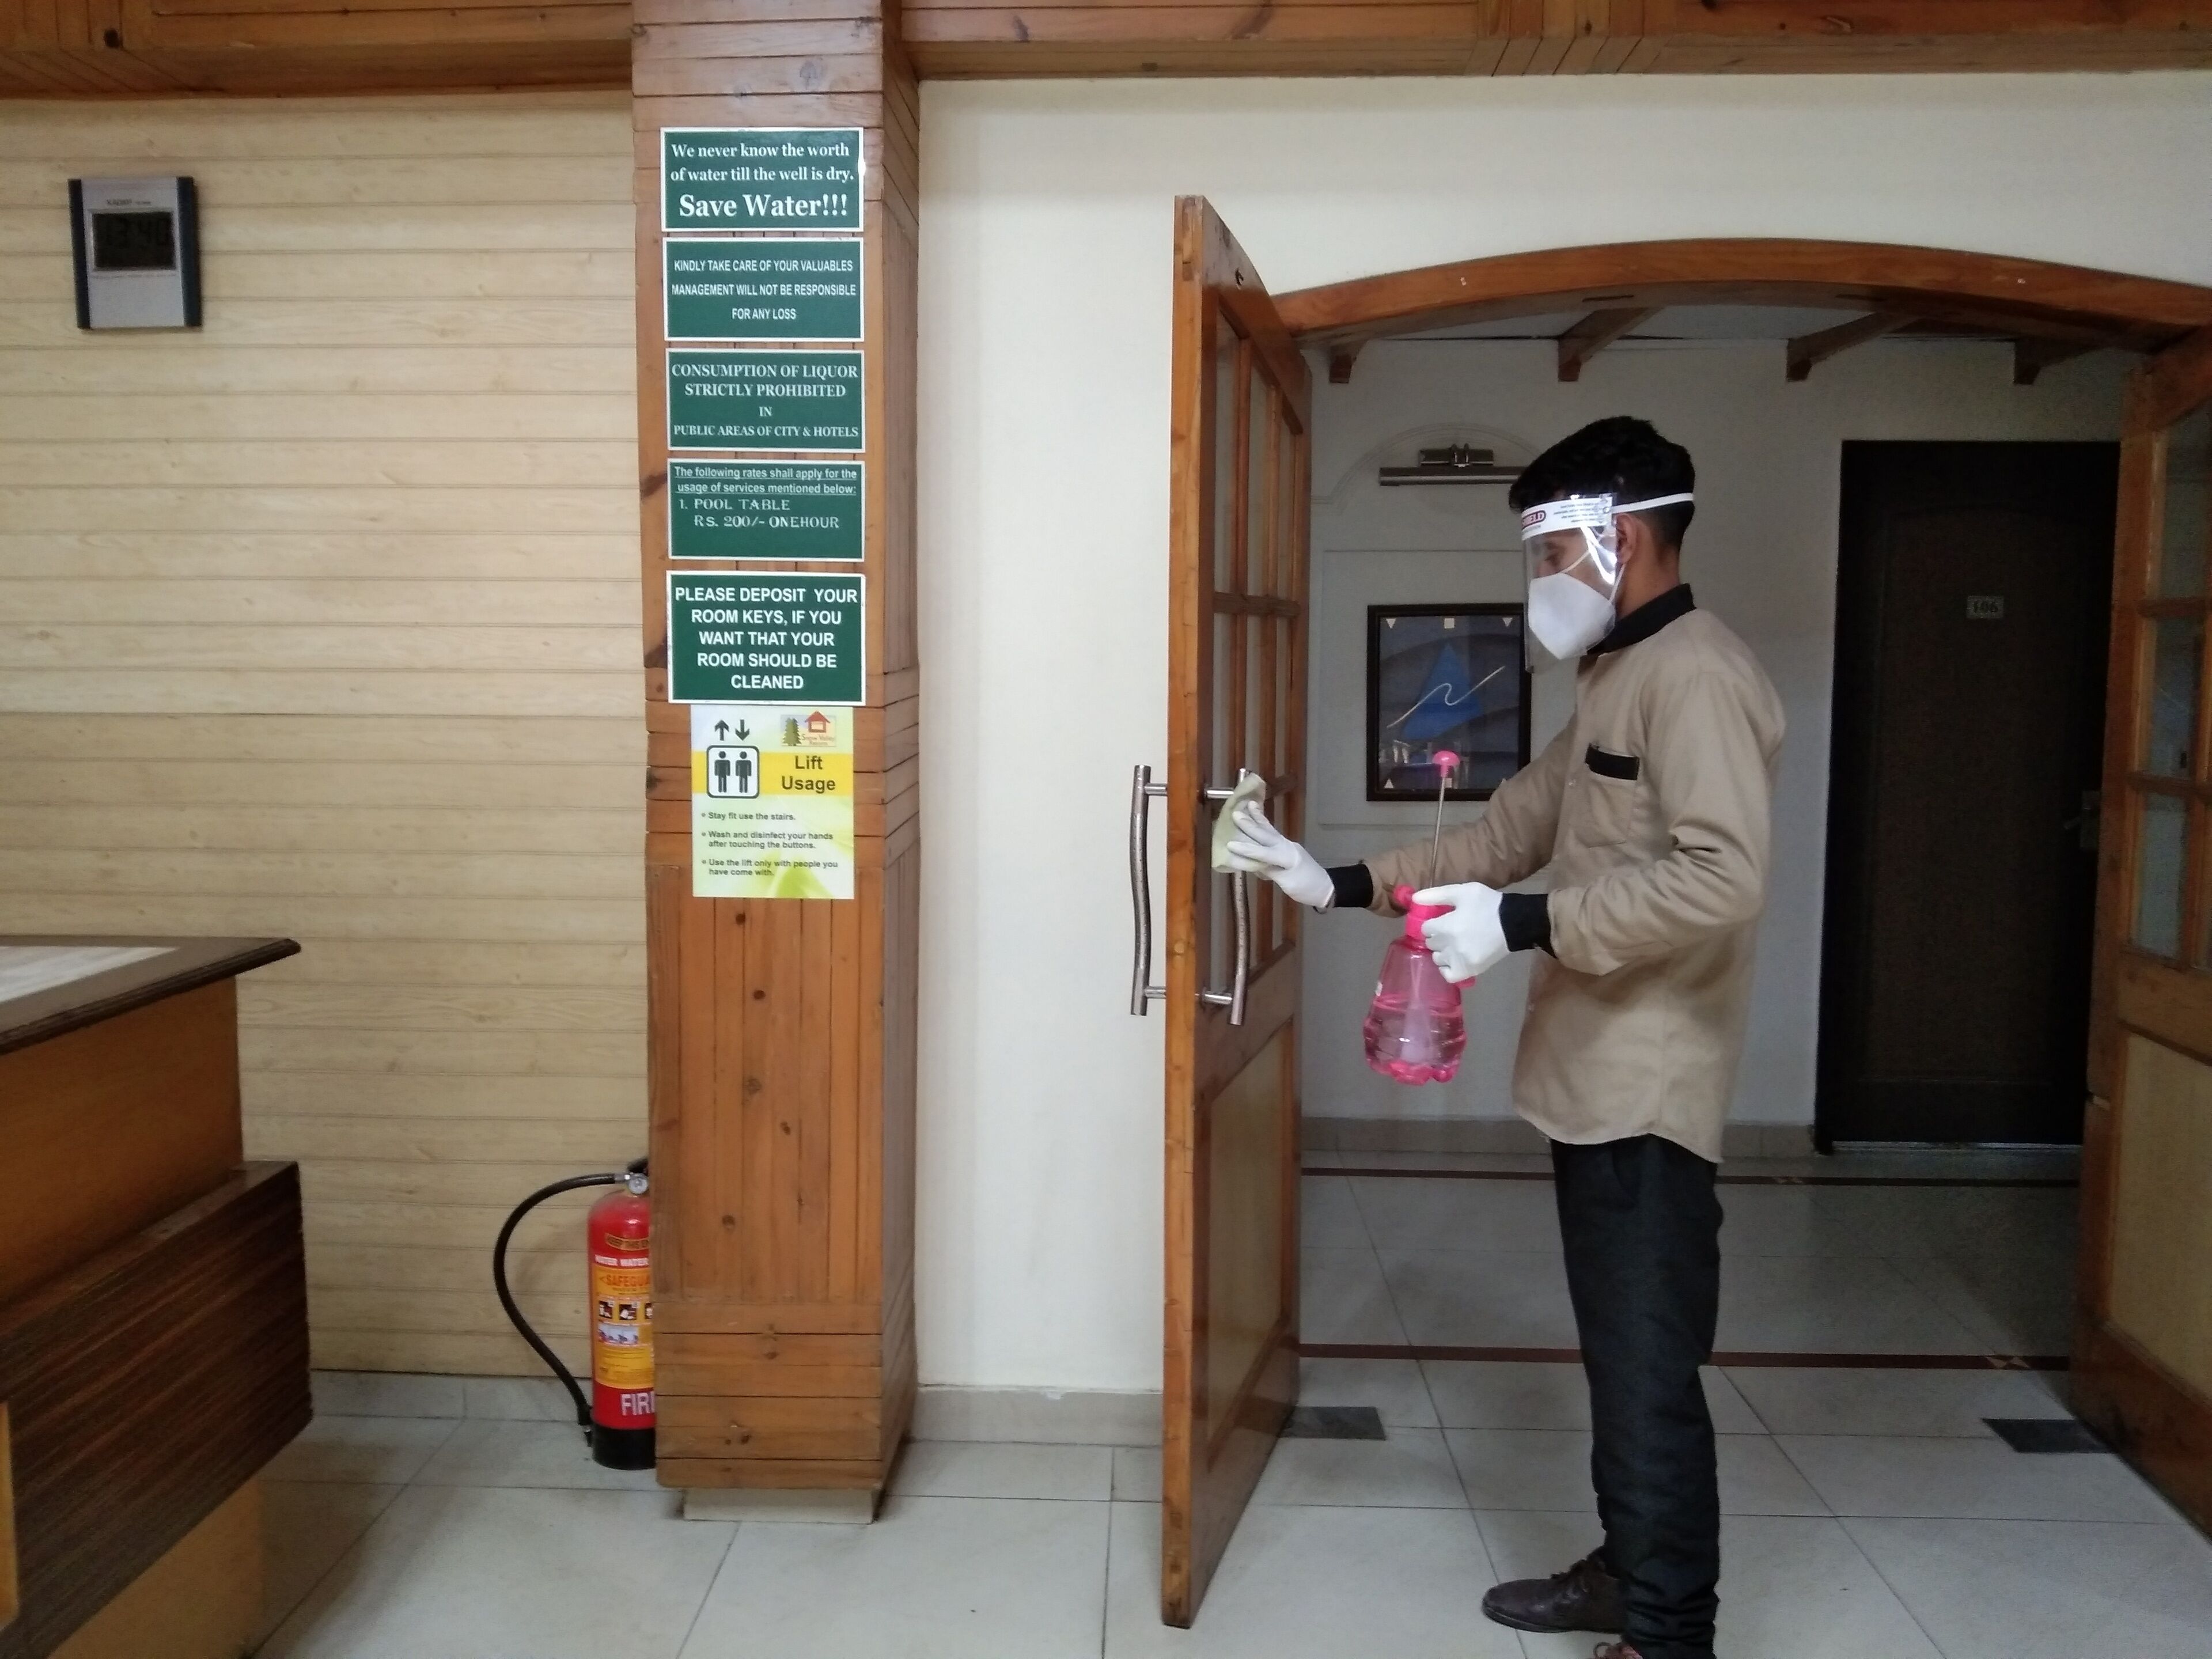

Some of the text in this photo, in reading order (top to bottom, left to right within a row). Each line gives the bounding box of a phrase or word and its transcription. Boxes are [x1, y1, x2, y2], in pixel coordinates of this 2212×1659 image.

[671, 142, 849, 157] We never know the worth
[671, 166, 853, 183] of water till the well is dry.
[680, 194, 847, 217] Save Water!!!
[675, 260, 853, 271] KINDLY TAKE CARE OF YOUR VALUABLES
[672, 284, 855, 296] MANAGEMENT WILL NOT BE RESPONSIBLE
[732, 308, 796, 319] FOR ANY LOSS
[672, 365, 858, 380] CONSUMPTION OF LIQUOR
[685, 384, 846, 396] STRICTLY PROHIBITED
[759, 407, 772, 416] IN
[674, 425, 858, 437] PUBLIC AREAS OF CITY & HOTELS
[675, 467, 857, 480] The following rates shall apply for the
[678, 483, 856, 494] usage of services mentioned below:
[680, 499, 790, 510] 1. POOL TABLE
[724, 516, 764, 527] 200/-
[676, 588, 857, 603] PLEASE DEPOSIT YOUR
[692, 609, 841, 626] ROOM KEYS, IF YOU
[699, 631, 834, 646] WANT THAT YOUR
[698, 653, 836, 668] ROOM SHOULD BE
[732, 675, 804, 689] CLEANED
[796, 756, 823, 770] Lift
[782, 776, 835, 794] Usage
[709, 812, 725, 820] Stay
[783, 840, 815, 849] buttons.
[755, 860, 771, 868] only
[755, 868, 774, 876] with.
